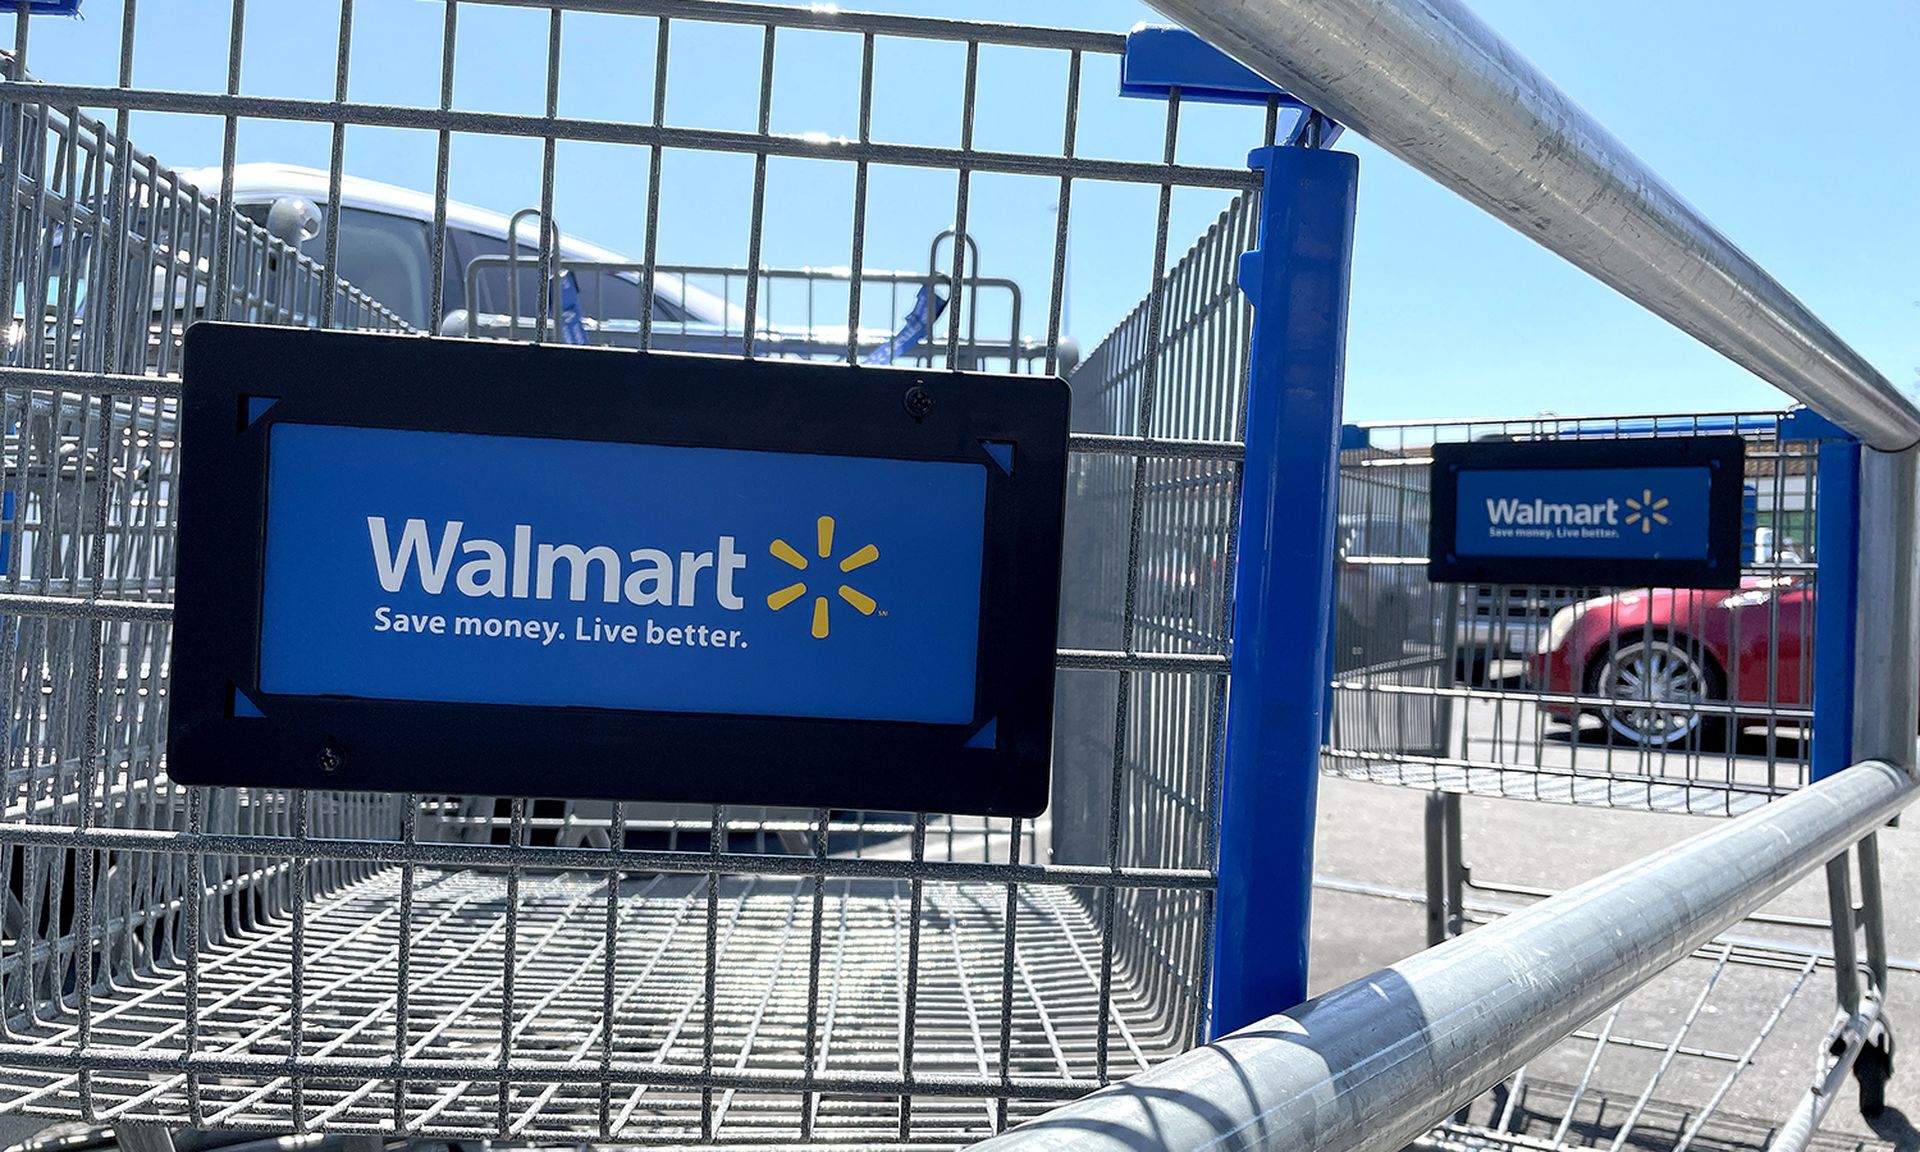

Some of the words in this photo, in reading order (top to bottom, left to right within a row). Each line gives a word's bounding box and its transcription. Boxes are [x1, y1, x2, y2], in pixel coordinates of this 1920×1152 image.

[1486, 498, 1619, 525] Walmart
[1489, 527, 1515, 537] Save
[1516, 528, 1553, 540] money.
[1556, 528, 1580, 537] Live
[1581, 528, 1619, 539] better.
[367, 516, 747, 610] Walmart
[374, 606, 446, 634] Save
[454, 614, 566, 648] money.
[575, 616, 639, 643] Live
[646, 619, 748, 649] better.
